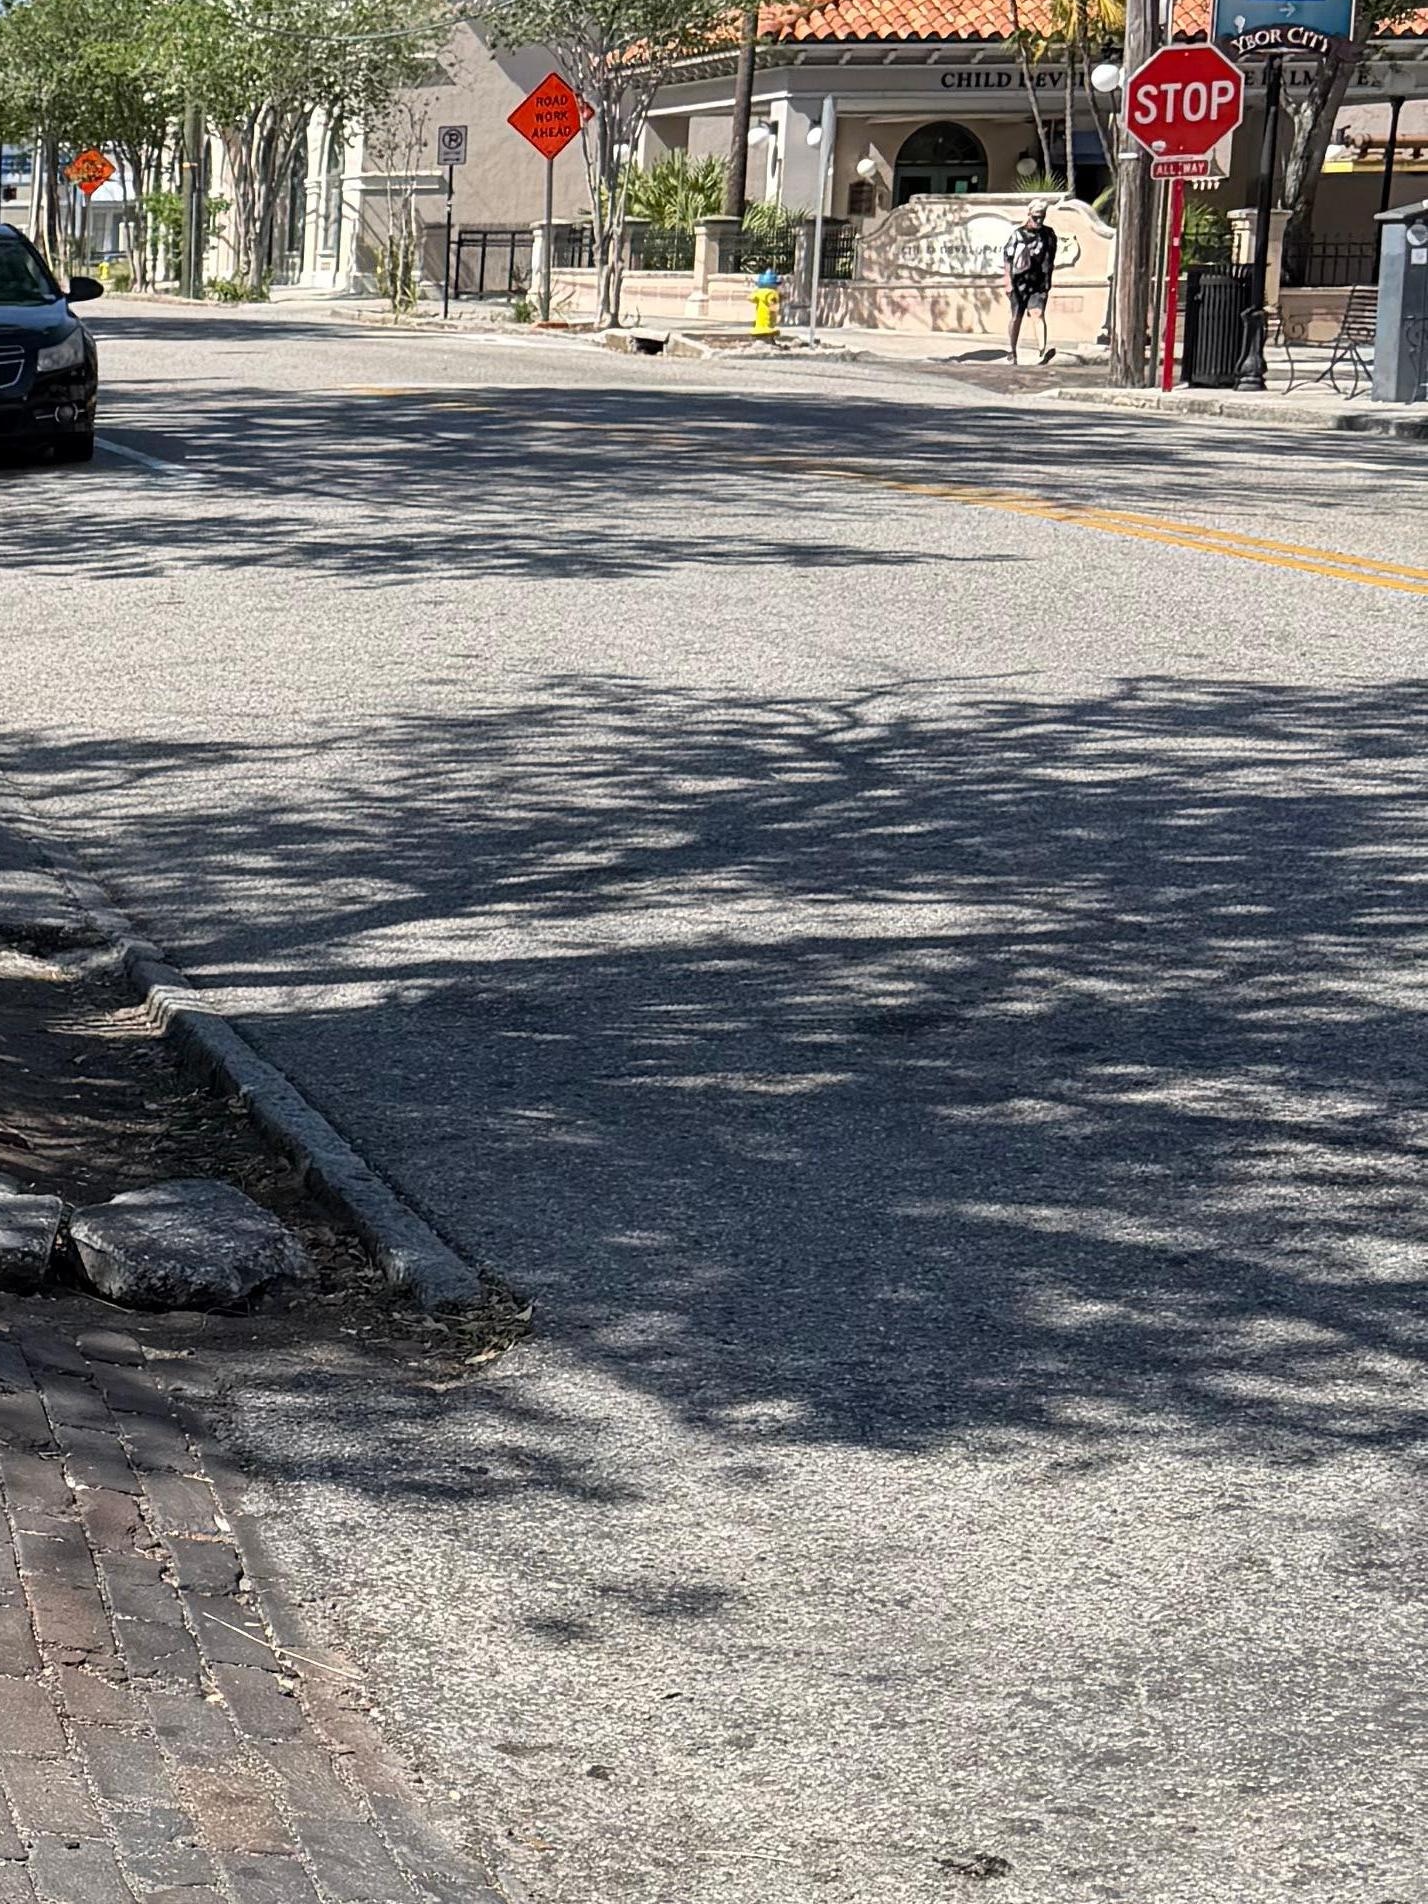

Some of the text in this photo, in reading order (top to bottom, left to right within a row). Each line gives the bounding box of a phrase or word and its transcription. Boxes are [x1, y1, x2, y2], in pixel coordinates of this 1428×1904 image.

[1231, 28, 1282, 54] YBOR
[941, 71, 1012, 88] CHILD
[536, 95, 569, 107] ROAD
[1134, 80, 1235, 125] STOP
[535, 110, 568, 123] WORK
[531, 126, 572, 139] AHEAD
[1156, 162, 1205, 175] ALL WAY
